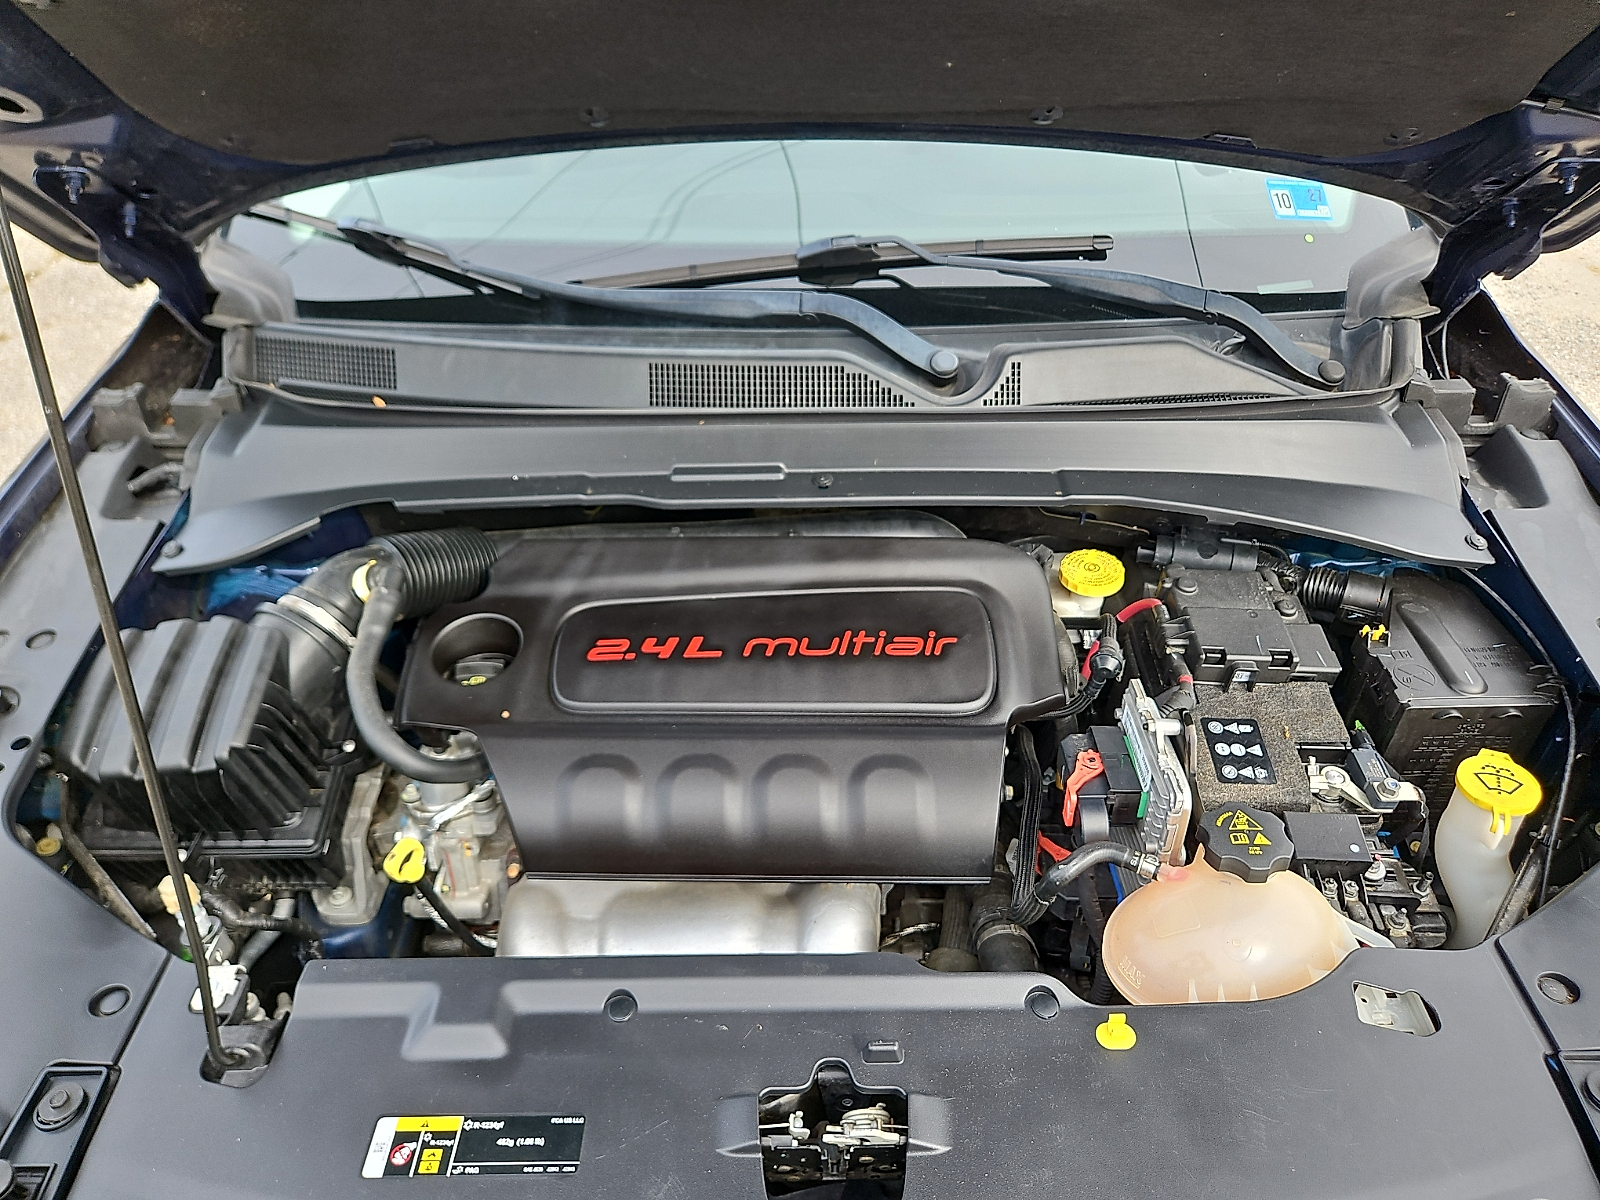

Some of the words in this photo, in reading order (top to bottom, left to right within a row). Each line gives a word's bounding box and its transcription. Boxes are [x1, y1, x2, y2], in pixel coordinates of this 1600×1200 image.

[1273, 192, 1292, 209] 10
[1307, 188, 1322, 202] 27
[586, 635, 723, 662] 2.4L
[742, 630, 958, 657] multiair
